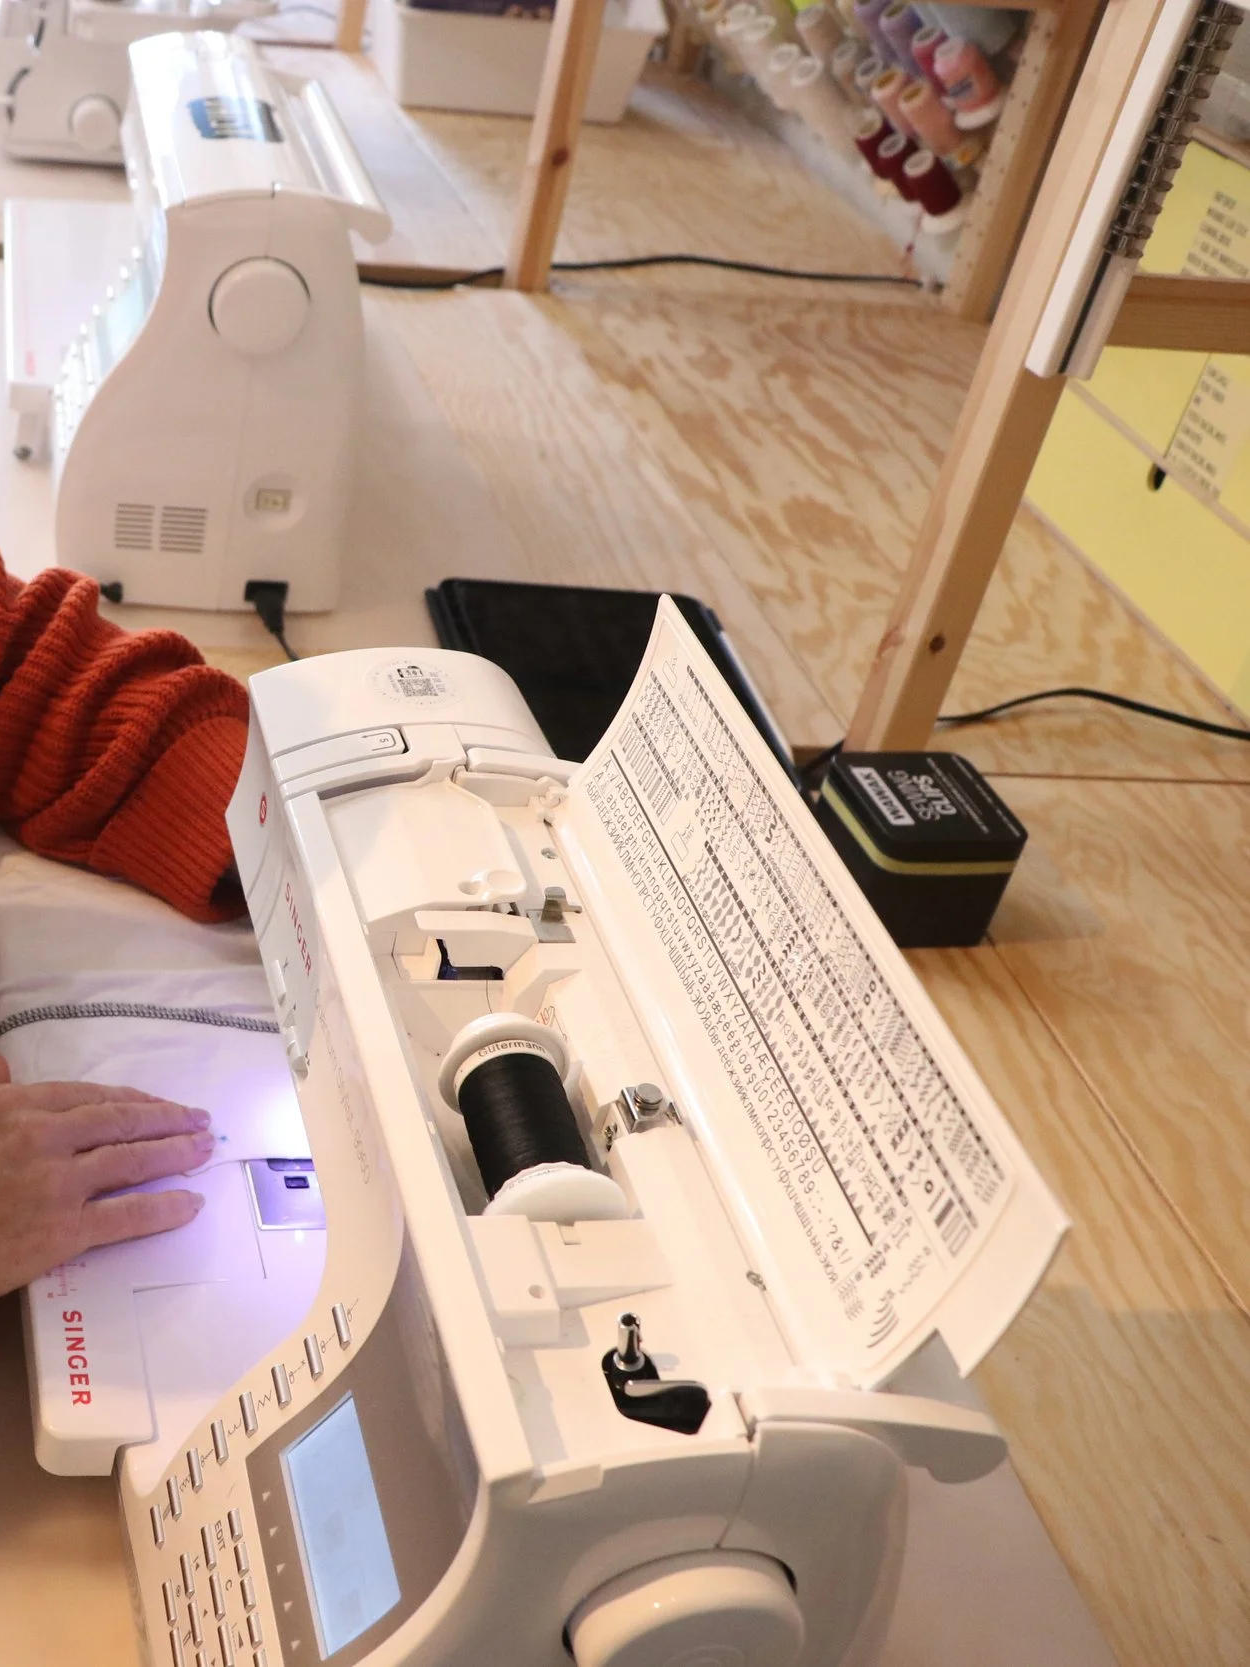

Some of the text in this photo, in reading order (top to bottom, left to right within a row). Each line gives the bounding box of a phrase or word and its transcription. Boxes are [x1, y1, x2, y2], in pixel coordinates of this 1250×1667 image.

[860, 770, 905, 821] WAWAK
[886, 769, 941, 822] SEWING
[912, 774, 958, 817] CLIPS
[285, 882, 313, 977] SINGER
[478, 1041, 546, 1058] Gütermann
[62, 1310, 92, 1406] SINGER
[214, 1519, 227, 1552] EDIT
